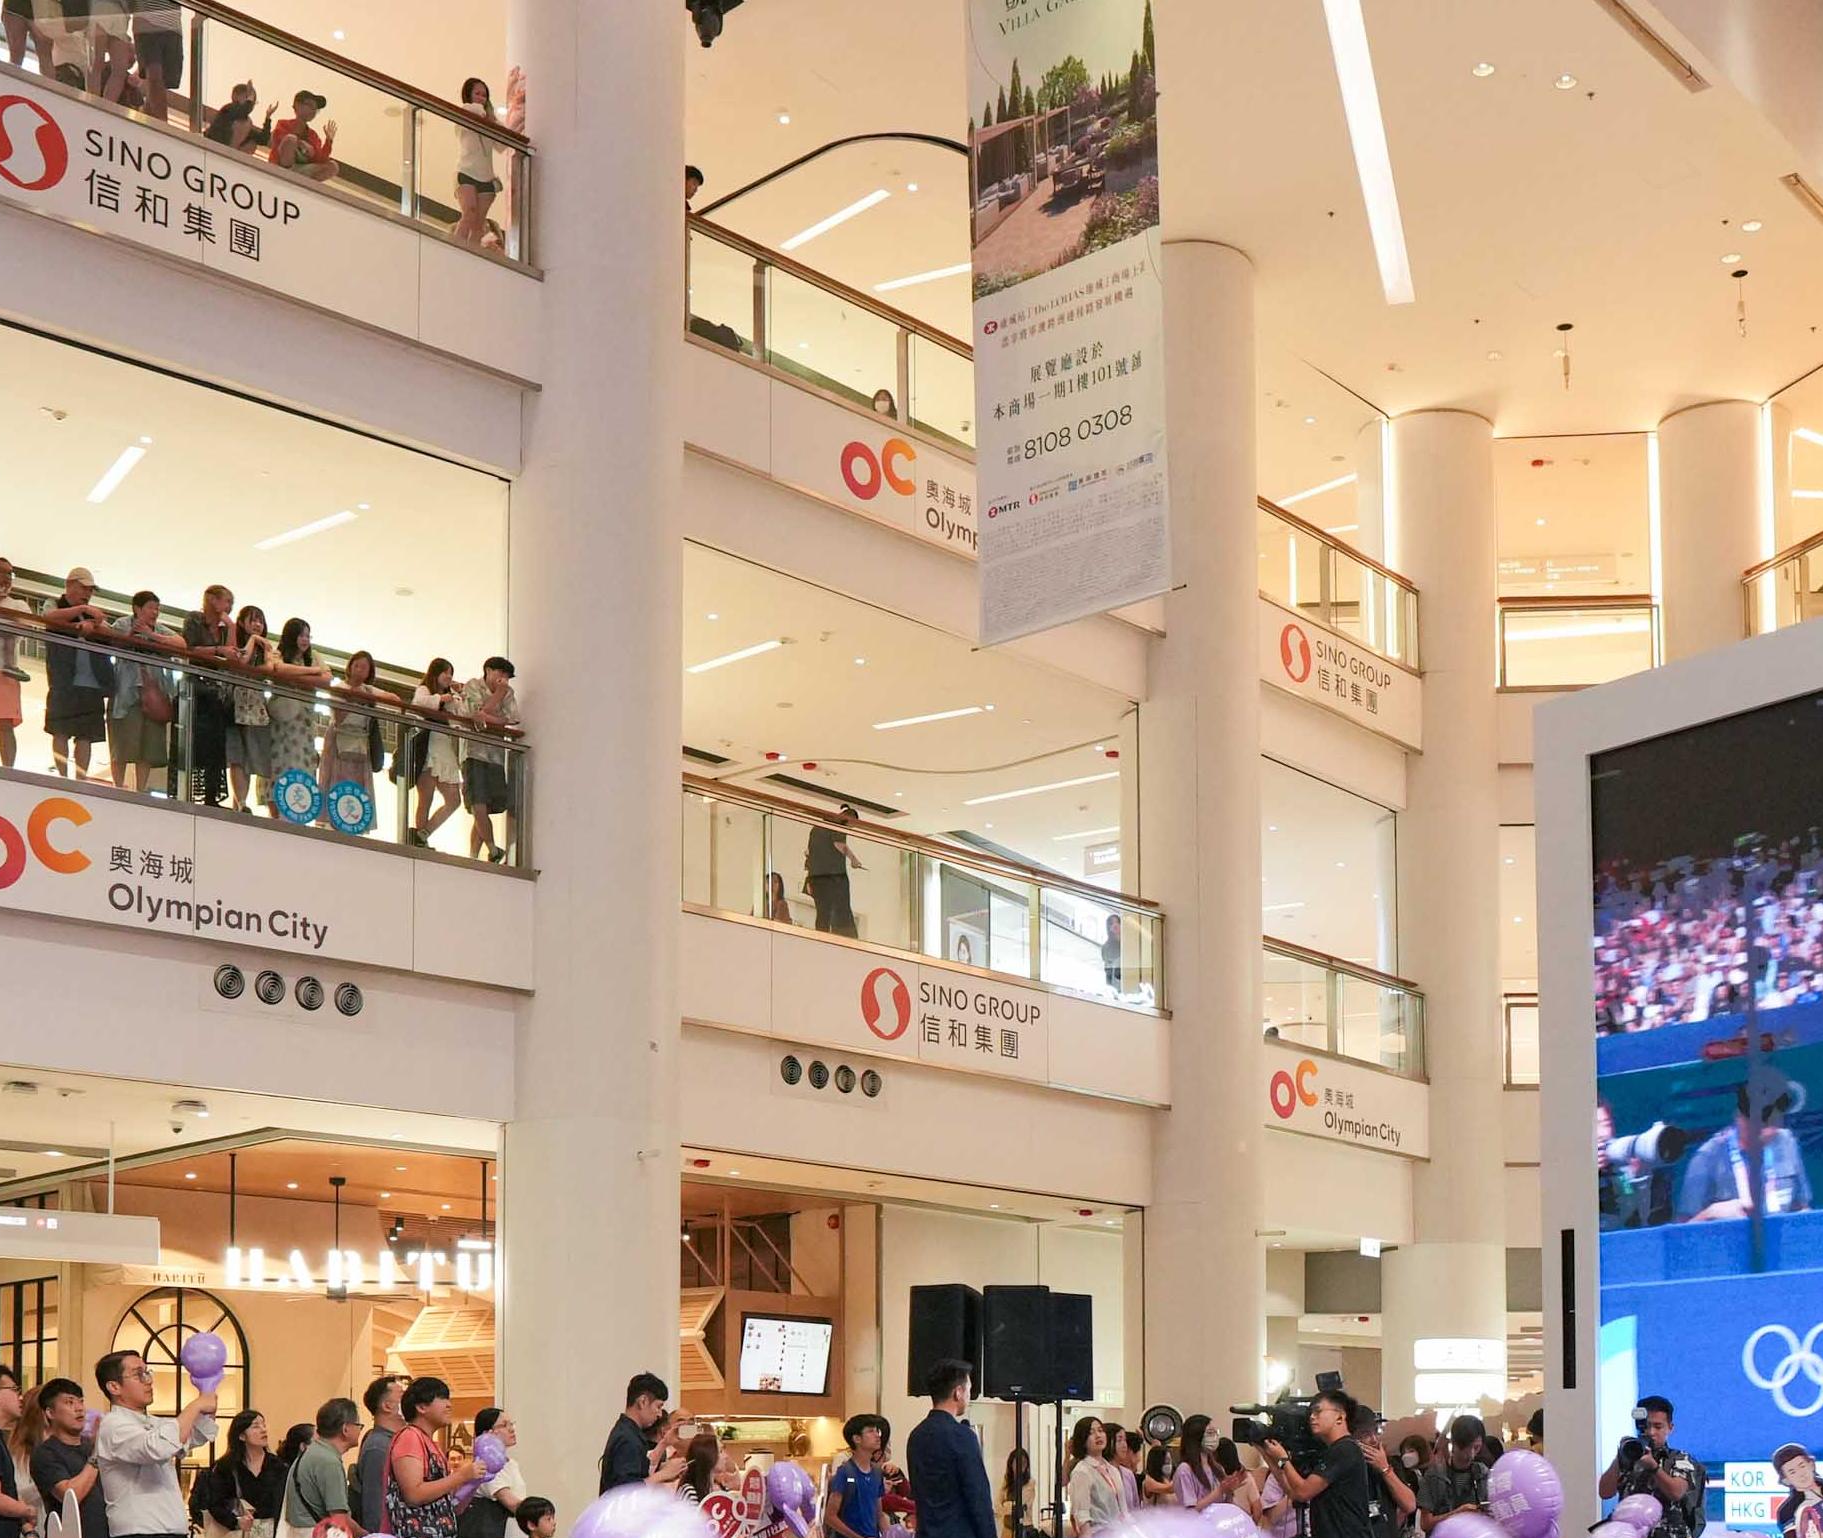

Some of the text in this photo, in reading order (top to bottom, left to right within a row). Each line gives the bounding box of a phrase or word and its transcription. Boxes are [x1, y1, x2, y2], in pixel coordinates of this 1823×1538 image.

[85, 128, 301, 225] SINO GROUP
[84, 168, 261, 262] 信和集團
[1024, 427, 1072, 459] 8108
[1077, 405, 1133, 440] 0308
[841, 438, 917, 501] OC
[926, 479, 972, 517] 奧海城
[998, 500, 1021, 514] MTR
[1316, 640, 1391, 690] SINO GROUP
[1317, 664, 1378, 715] 信和集團
[108, 845, 194, 885] 奧海城
[108, 883, 329, 950] Olympian City
[919, 981, 1042, 1026] SINO GROUP
[920, 1012, 1019, 1059] 信和集團
[1270, 1059, 1319, 1119] OC
[1324, 1111, 1402, 1147] Olympian City
[1731, 1470, 1766, 1487] KOR
[1731, 1503, 1766, 1519] HKG
